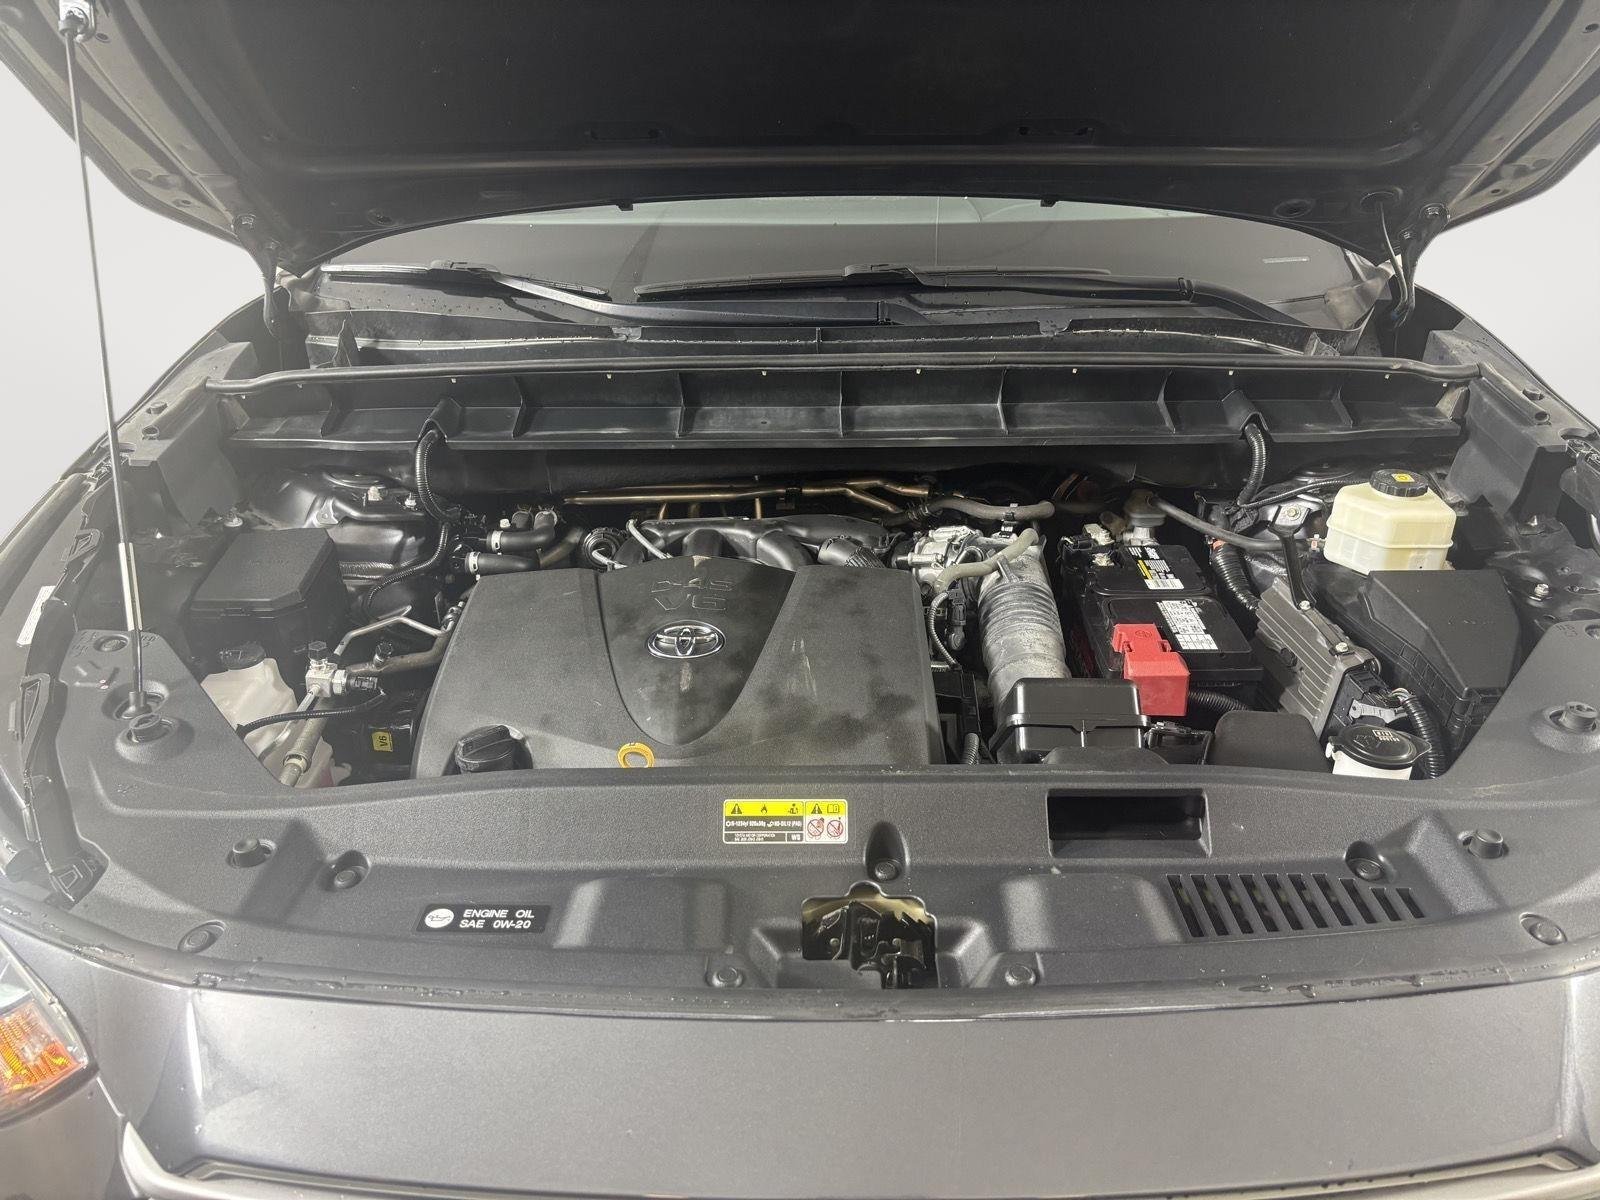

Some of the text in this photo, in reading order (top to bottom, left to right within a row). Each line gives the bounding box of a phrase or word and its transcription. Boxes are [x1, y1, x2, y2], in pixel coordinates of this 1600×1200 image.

[654, 593, 727, 611] V6
[378, 735, 388, 747] V6
[463, 909, 535, 919] ENGINE OIL
[459, 919, 532, 929] SAE 0W-20
